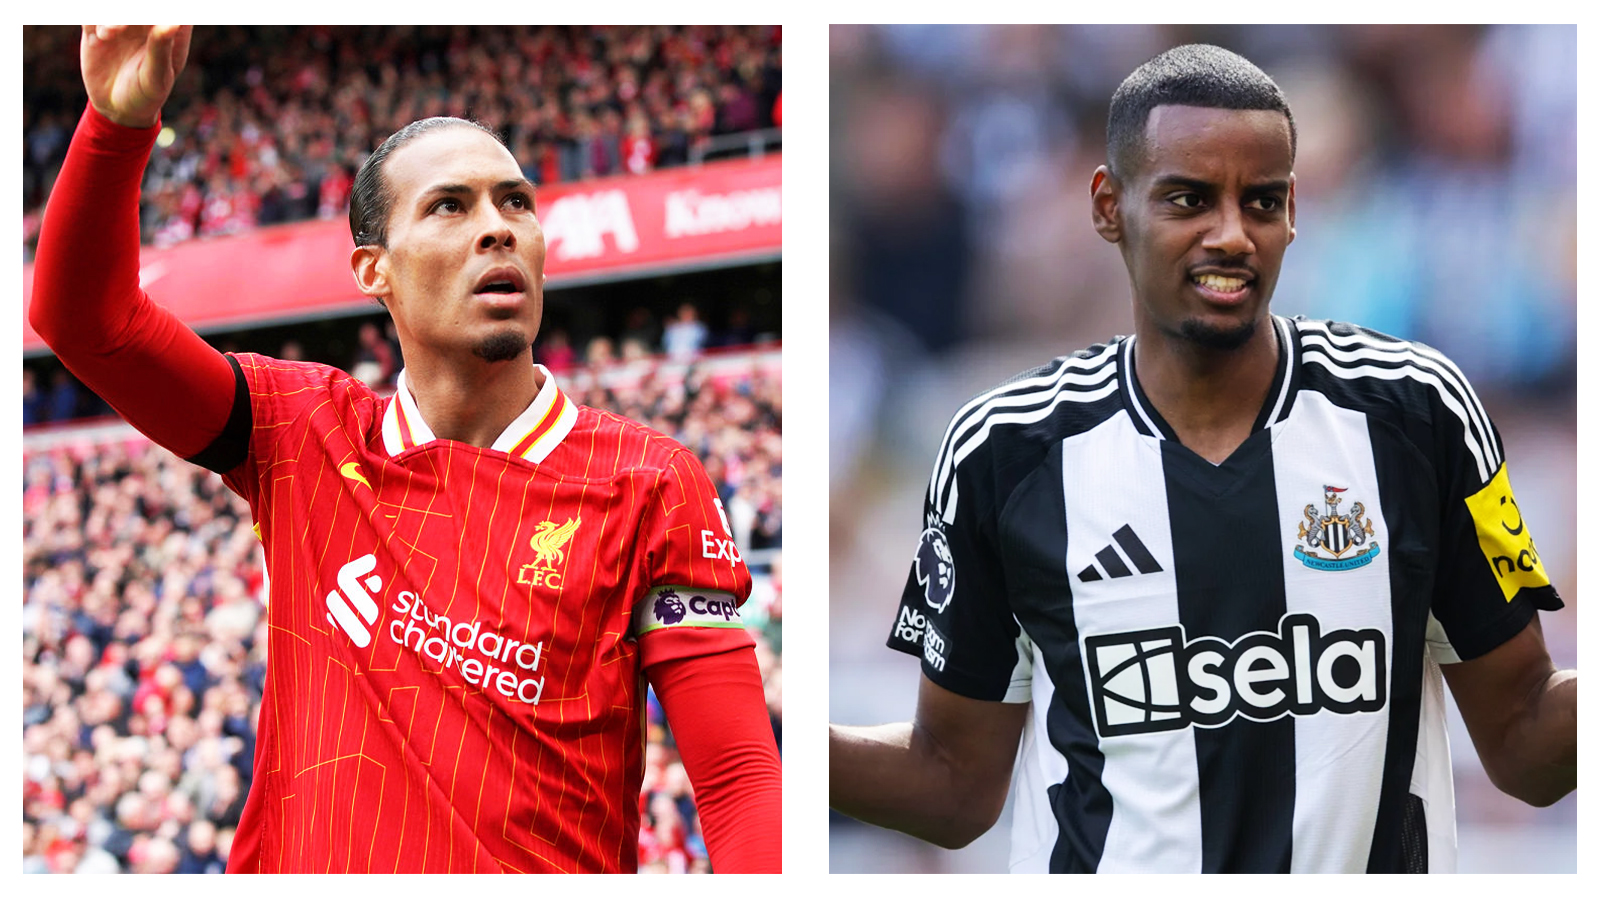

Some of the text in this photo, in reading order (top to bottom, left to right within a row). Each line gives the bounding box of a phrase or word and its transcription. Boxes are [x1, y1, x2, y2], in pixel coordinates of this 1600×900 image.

[1306, 556, 1369, 568] NEWCASTLE UNITED
[900, 605, 926, 629] No
[1187, 625, 1377, 714] sela
